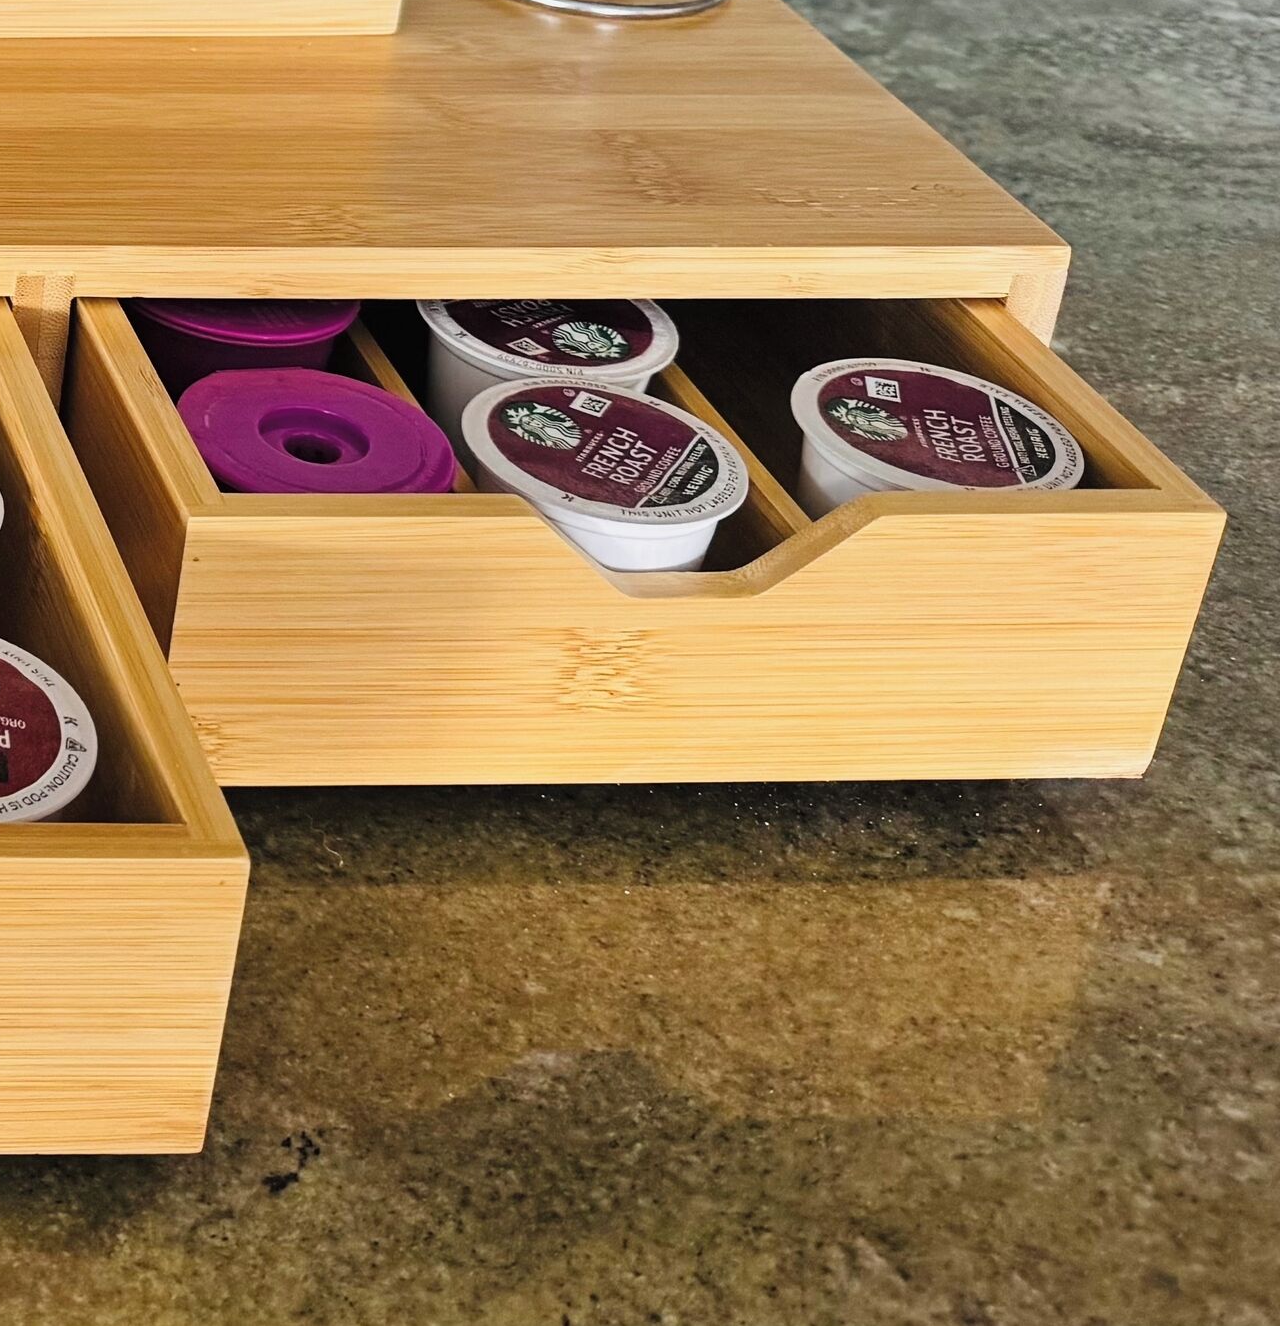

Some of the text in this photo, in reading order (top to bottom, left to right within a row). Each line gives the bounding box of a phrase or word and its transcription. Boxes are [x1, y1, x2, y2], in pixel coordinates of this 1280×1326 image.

[582, 426, 639, 479] FRENCH
[923, 408, 962, 464] FRENCH
[950, 415, 988, 463] ROAST
[988, 440, 1010, 468] GROUND
[609, 440, 659, 486] ROAST
[635, 446, 683, 494] GROUND COFFEE
[681, 465, 714, 496] KEURIG
[684, 504, 707, 516] NOT
[9, 801, 23, 812] IS
[25, 787, 48, 807] POD
